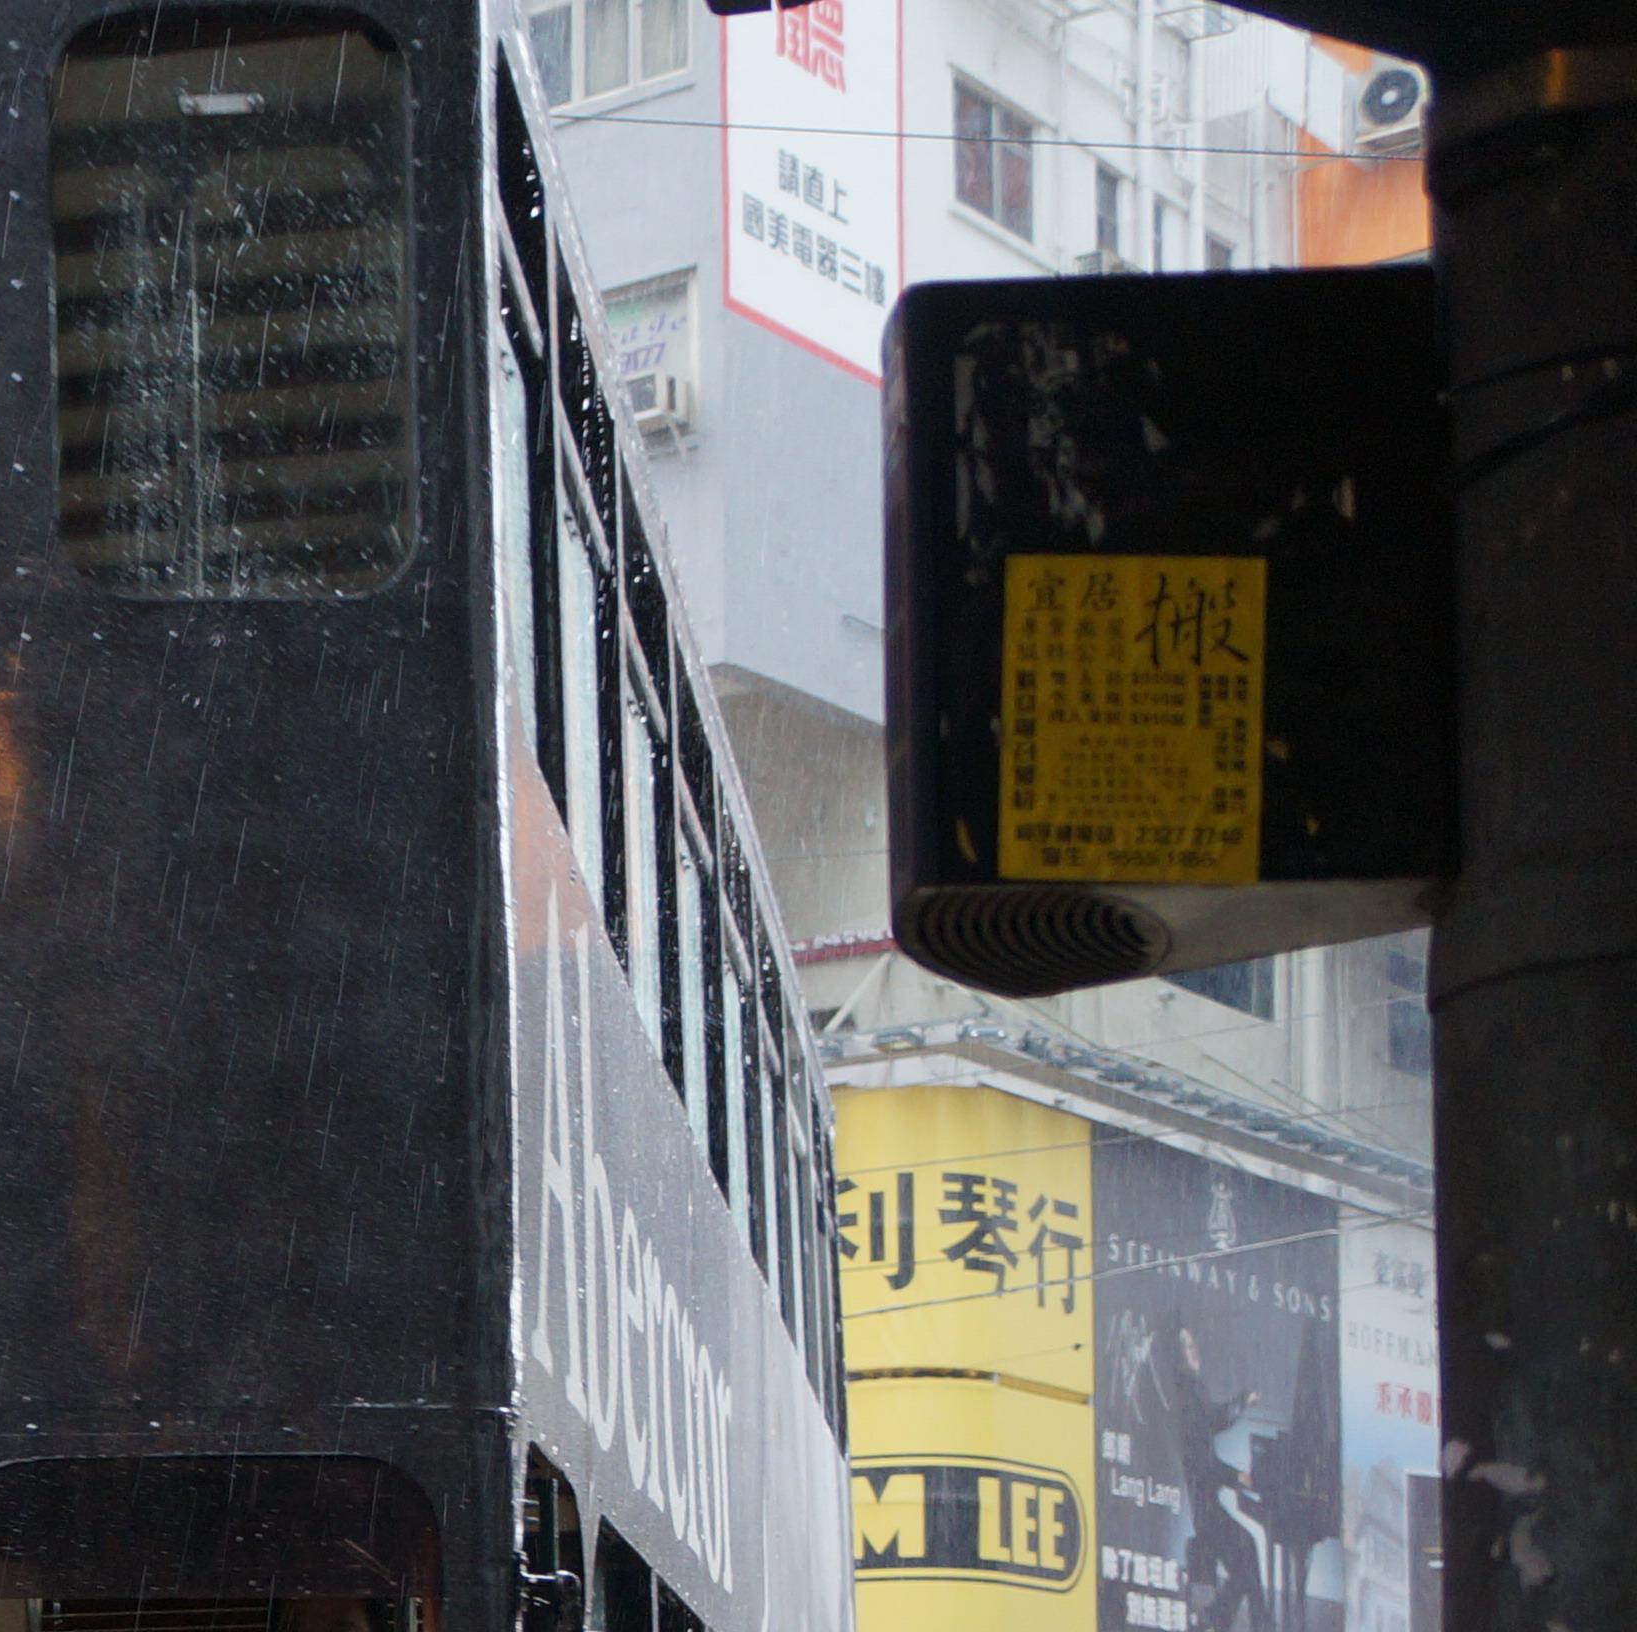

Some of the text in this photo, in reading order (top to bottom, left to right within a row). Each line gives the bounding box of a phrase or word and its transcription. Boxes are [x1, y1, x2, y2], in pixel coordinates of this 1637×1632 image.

[1107, 1232, 1238, 1296] STEINWAY
[1274, 1282, 1332, 1323] SONS
[977, 1476, 1066, 1573] LEE
